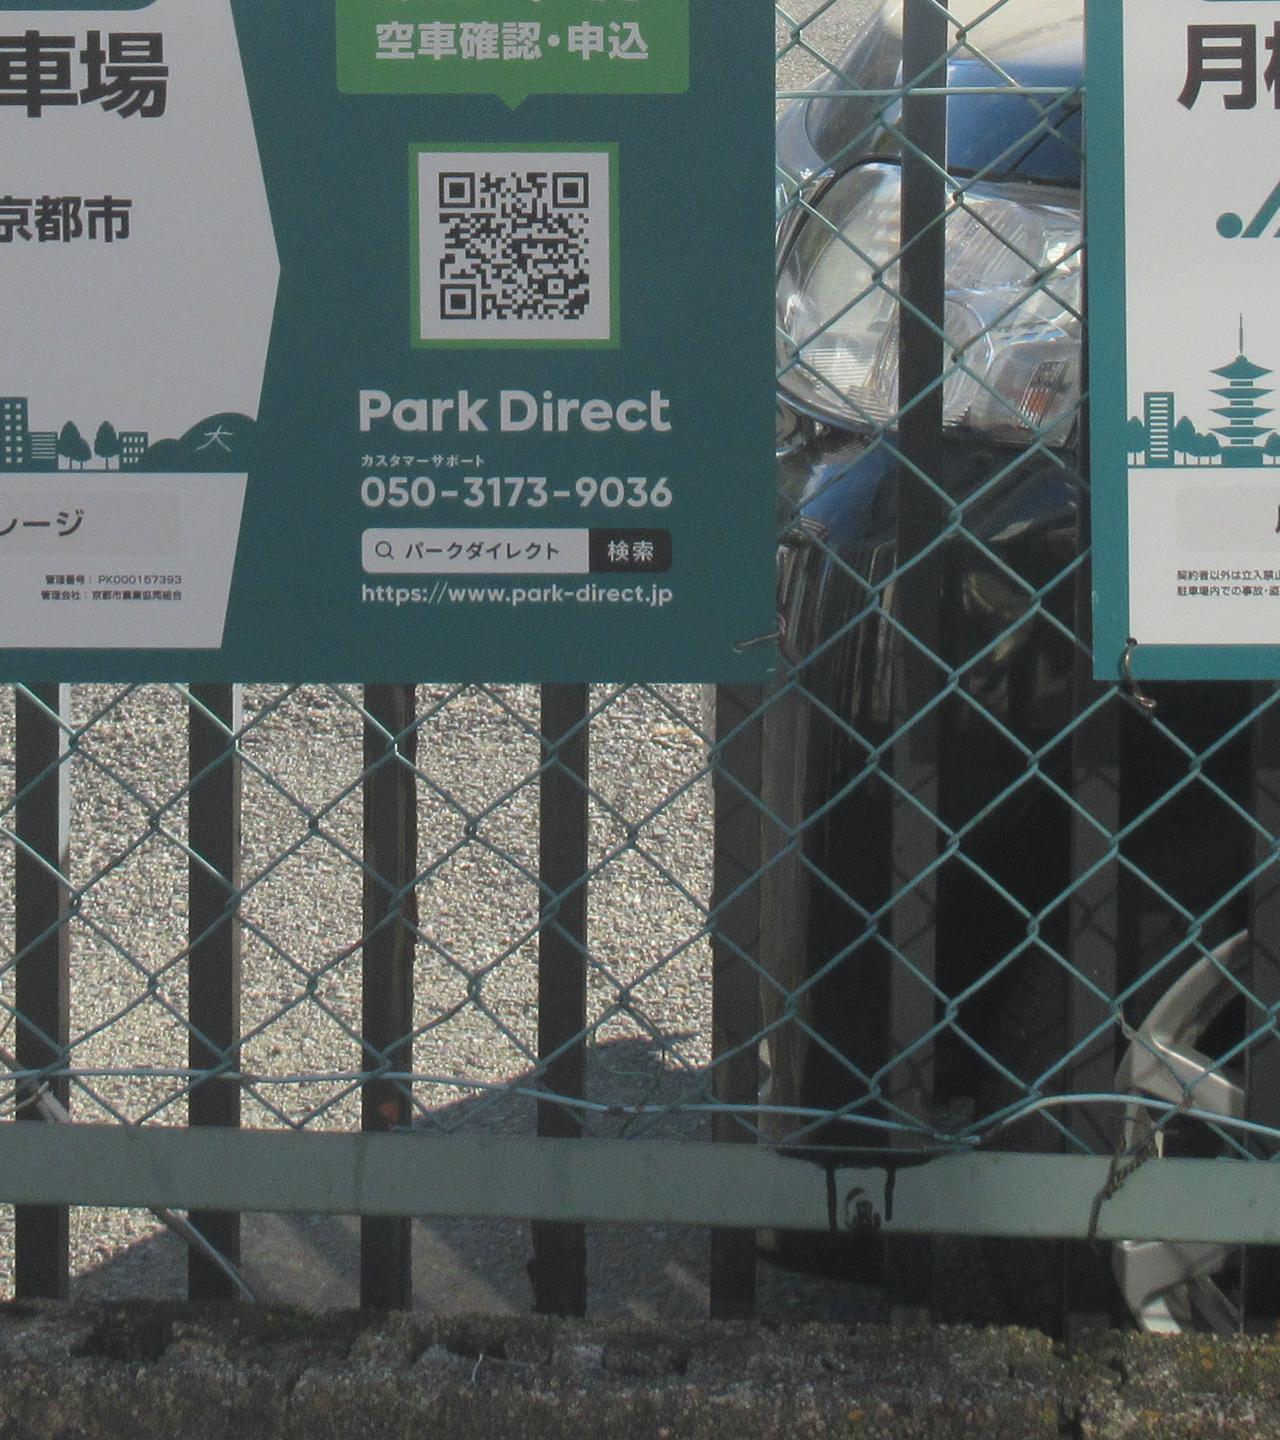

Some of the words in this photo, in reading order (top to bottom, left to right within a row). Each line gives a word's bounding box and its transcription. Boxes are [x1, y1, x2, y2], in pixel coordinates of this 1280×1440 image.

[375, 20, 649, 61] 空車確認・申込
[359, 389, 489, 432] Park
[499, 389, 672, 432] Direct
[361, 454, 485, 468] カスタマーサポート
[360, 476, 673, 508] 050-3173-9036
[405, 541, 559, 561] パークダイレクト
[607, 540, 654, 562] 検索
[361, 582, 673, 607] https://www.park-direct.jp
